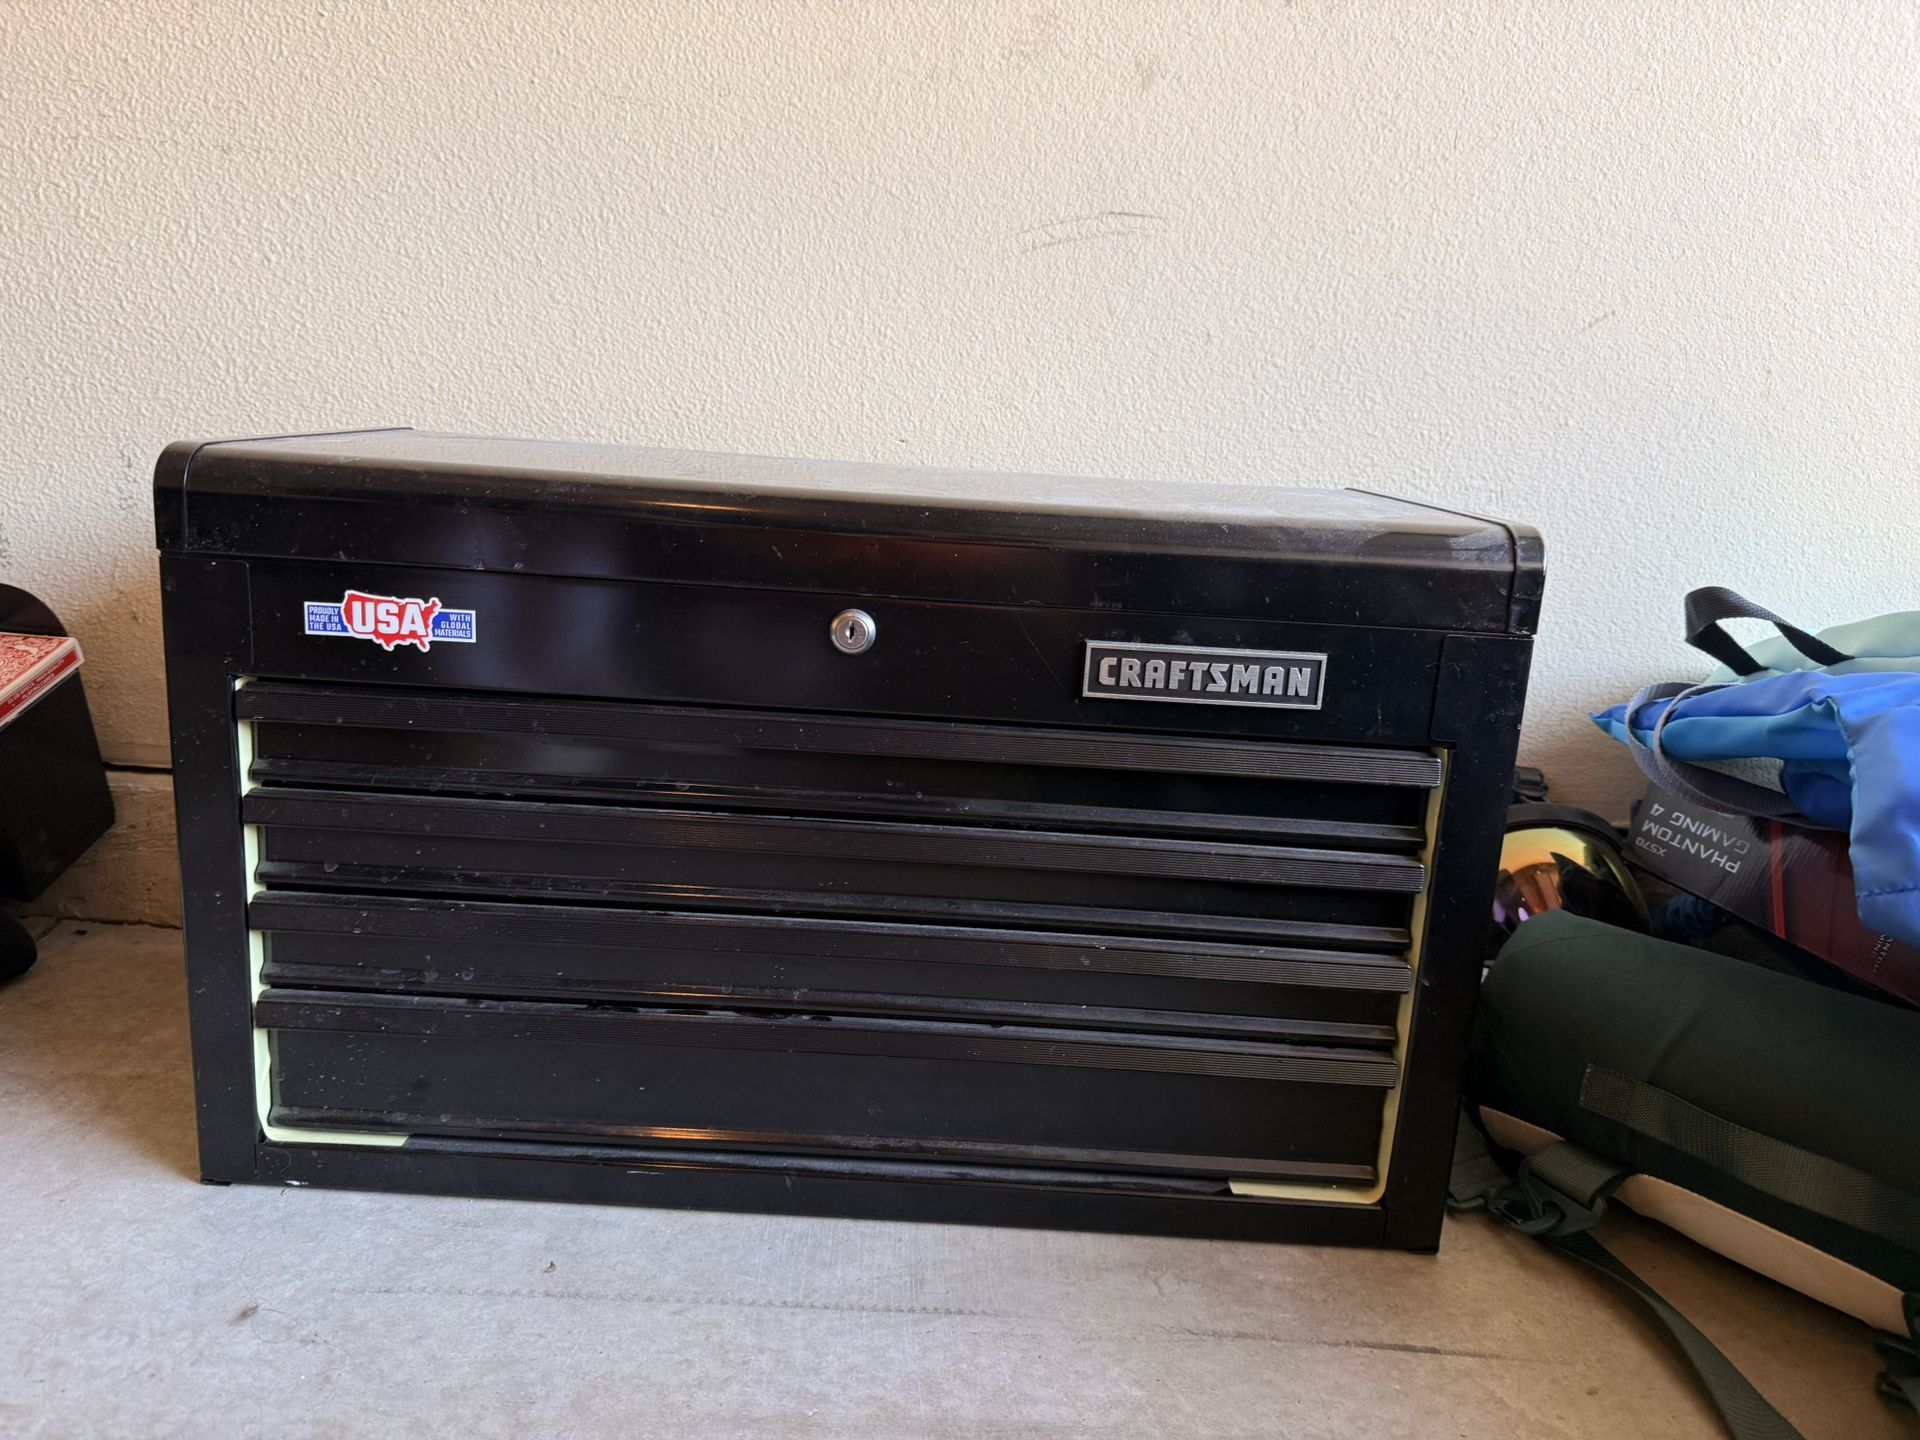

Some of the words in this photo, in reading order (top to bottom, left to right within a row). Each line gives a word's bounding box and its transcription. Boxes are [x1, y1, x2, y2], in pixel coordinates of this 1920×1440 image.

[308, 606, 339, 615] PROUDLY
[309, 614, 330, 623] MADE
[330, 615, 339, 623] IN
[351, 601, 427, 636] USA
[449, 613, 471, 622] WITH
[309, 622, 324, 631] THE
[325, 623, 342, 631] USA
[440, 621, 471, 630] GLOBAL
[434, 628, 471, 638] MATERIALS
[1098, 656, 1311, 696] CRAFTSMAN
[1649, 802, 1664, 817] 4
[1669, 811, 1750, 855] GAMING
[1635, 836, 1667, 857] X570
[1641, 819, 1742, 874] PHANTOM
